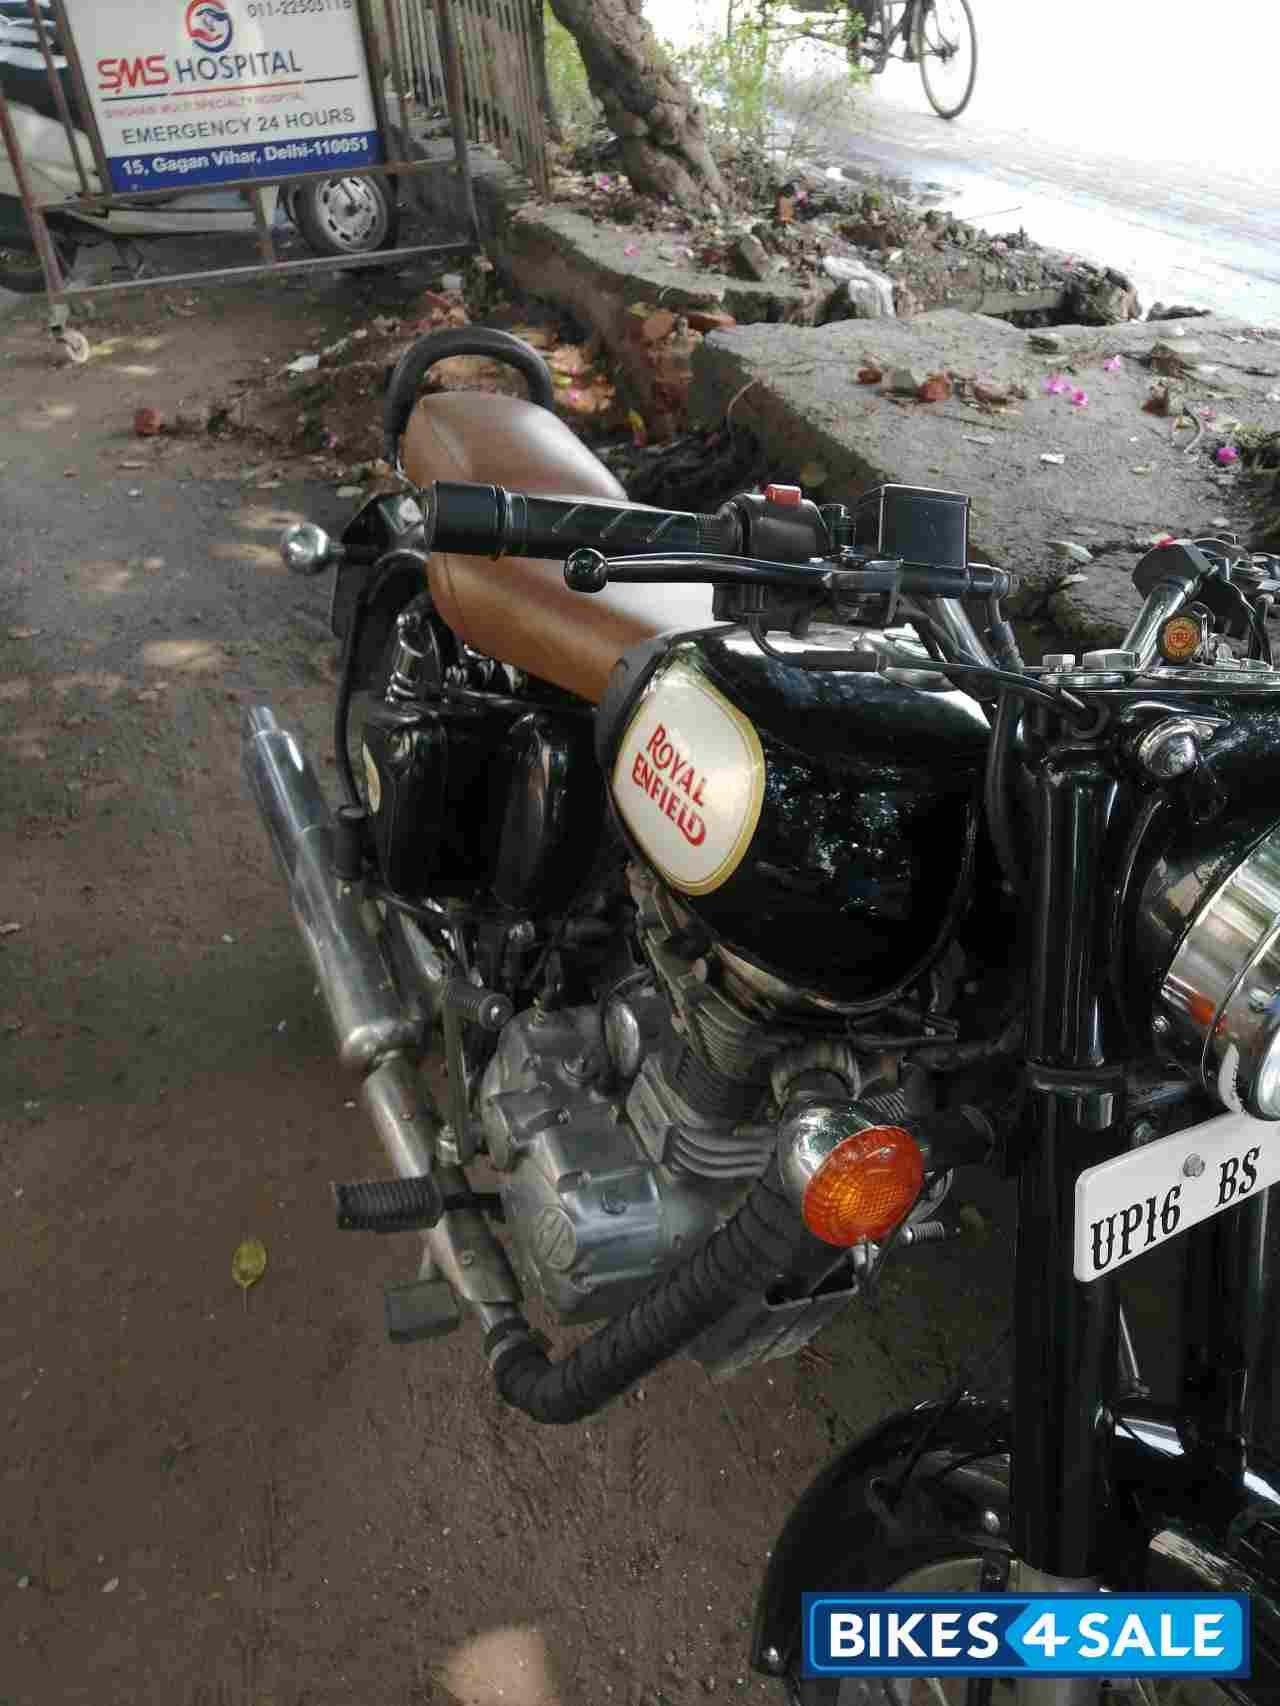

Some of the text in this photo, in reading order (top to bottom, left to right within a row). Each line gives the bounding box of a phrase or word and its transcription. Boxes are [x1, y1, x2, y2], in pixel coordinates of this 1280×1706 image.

[96, 50, 304, 94] SMS HOSPITAL
[121, 107, 356, 145] EMERGENCY 24 HOURS
[122, 160, 150, 176] 15,
[152, 155, 209, 175] Gagan
[211, 146, 262, 166] Vihar,
[646, 723, 707, 807] ROYAL
[631, 751, 707, 847] ENFIELD
[1090, 1145, 1262, 1270] UP16 BS
